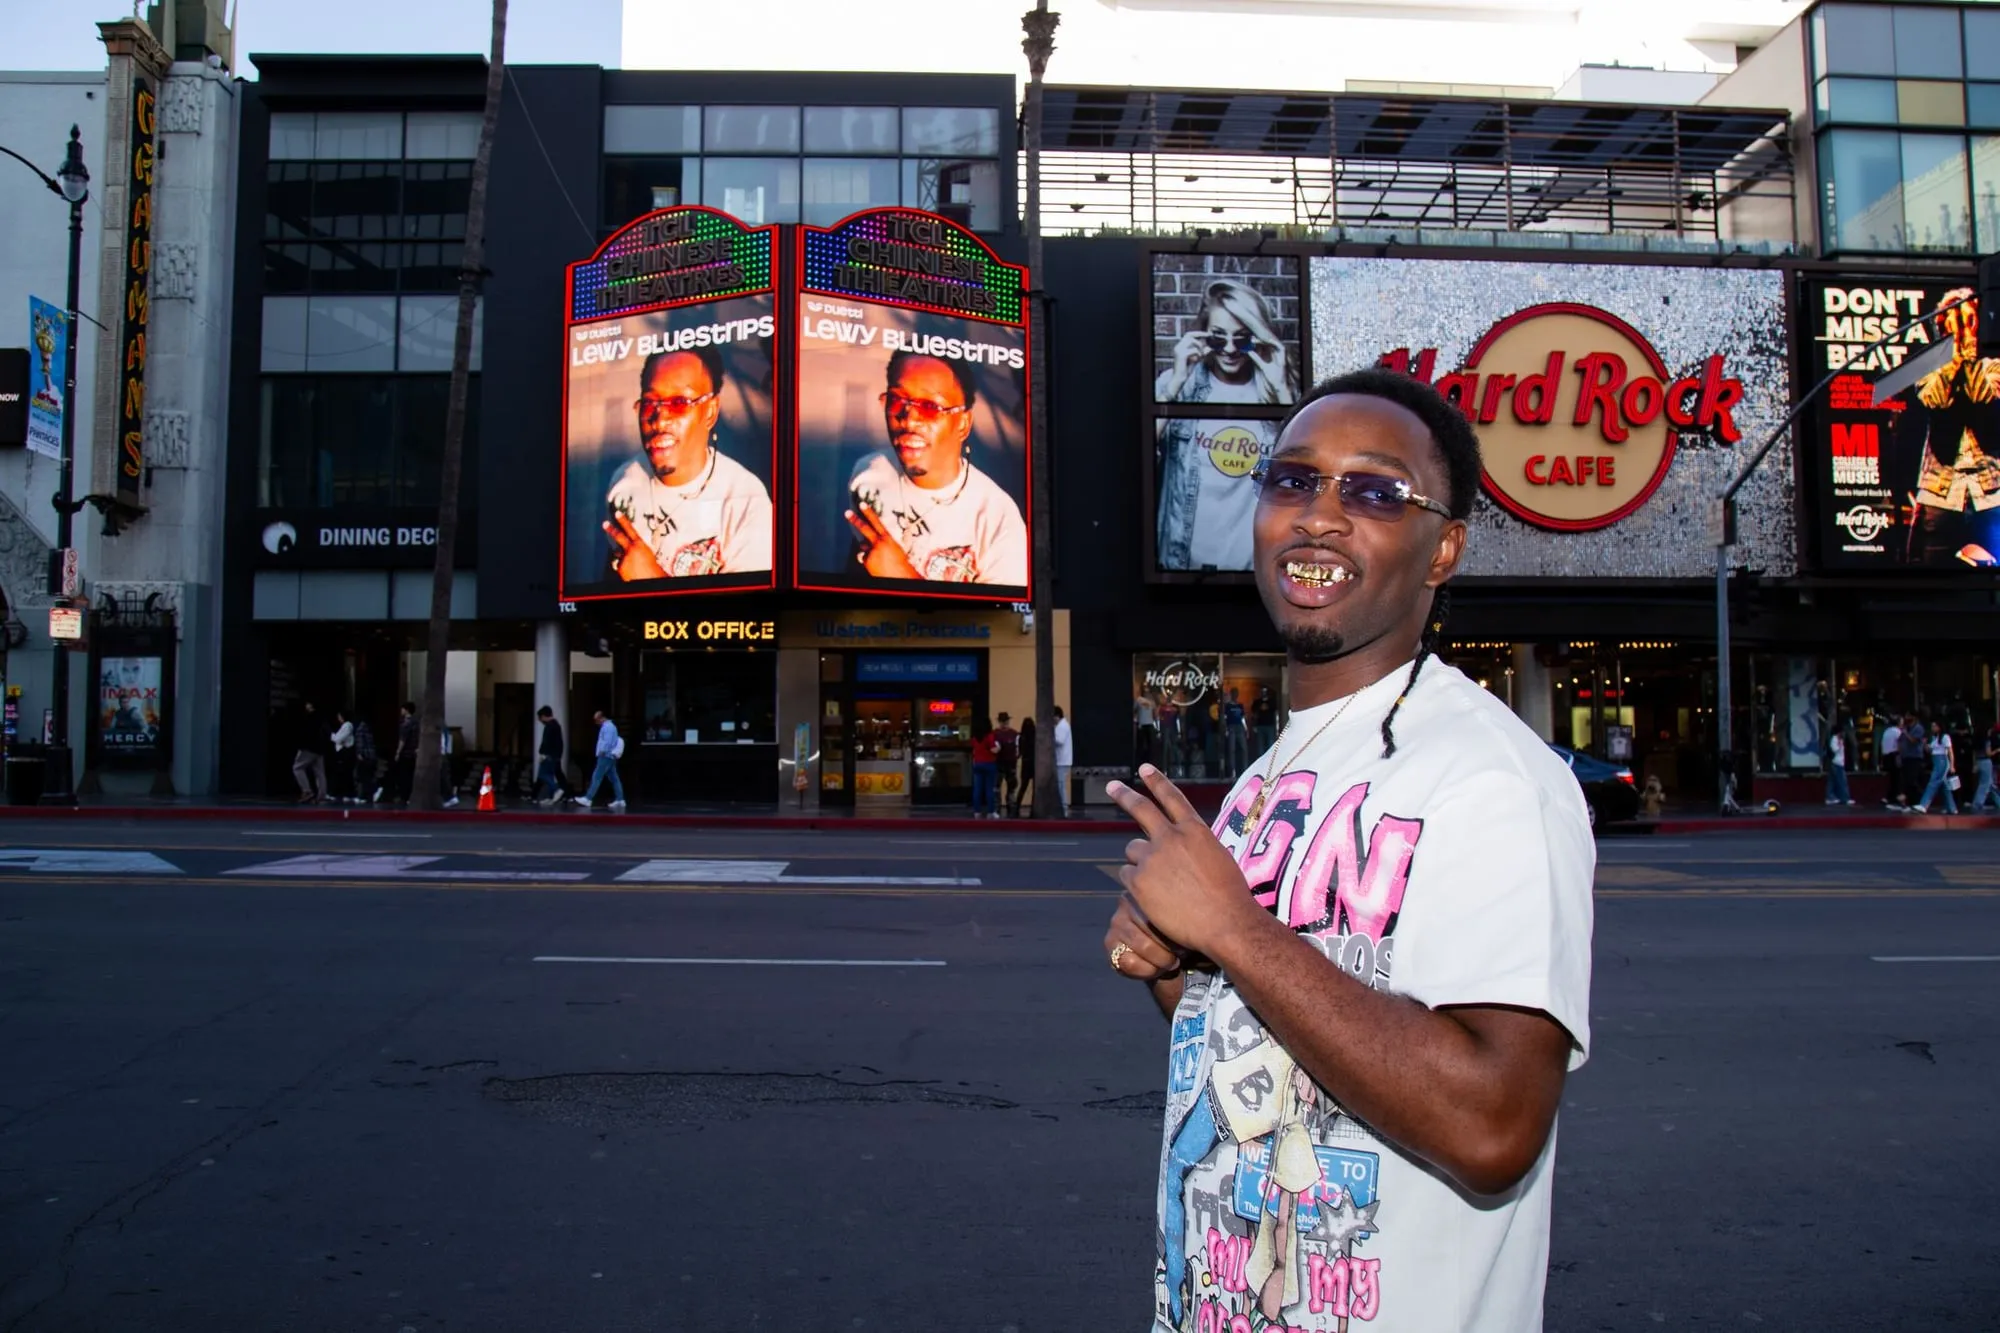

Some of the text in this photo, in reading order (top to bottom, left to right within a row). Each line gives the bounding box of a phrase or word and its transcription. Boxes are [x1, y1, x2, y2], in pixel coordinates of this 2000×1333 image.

[642, 215, 696, 245] TCL
[889, 214, 947, 247] TCL
[607, 236, 733, 279] CHINESE
[848, 236, 987, 283] CHINESE
[594, 264, 745, 310] THEATRES
[832, 262, 999, 313] THEATRES
[1824, 287, 1925, 315] DON'T
[1826, 316, 1930, 344] MISS A
[1827, 344, 1908, 371] BEAT
[1574, 350, 1744, 446] Rock
[1831, 424, 1879, 456] MI
[1222, 459, 1246, 469] CAFE
[1525, 454, 1616, 487] CAFE
[1833, 471, 1880, 484] MUSIC
[319, 527, 440, 546] DINING DEC
[559, 602, 577, 613] TCL
[1012, 602, 1032, 613] TCL
[644, 621, 774, 639] BOX OFFICE
[816, 621, 990, 638] Wetzel's Pretzels
[103, 687, 158, 699] IMAX
[1144, 669, 1221, 690] Hard Rock
[104, 733, 156, 743] MERCY
[1340, 1161, 1366, 1180] TO
